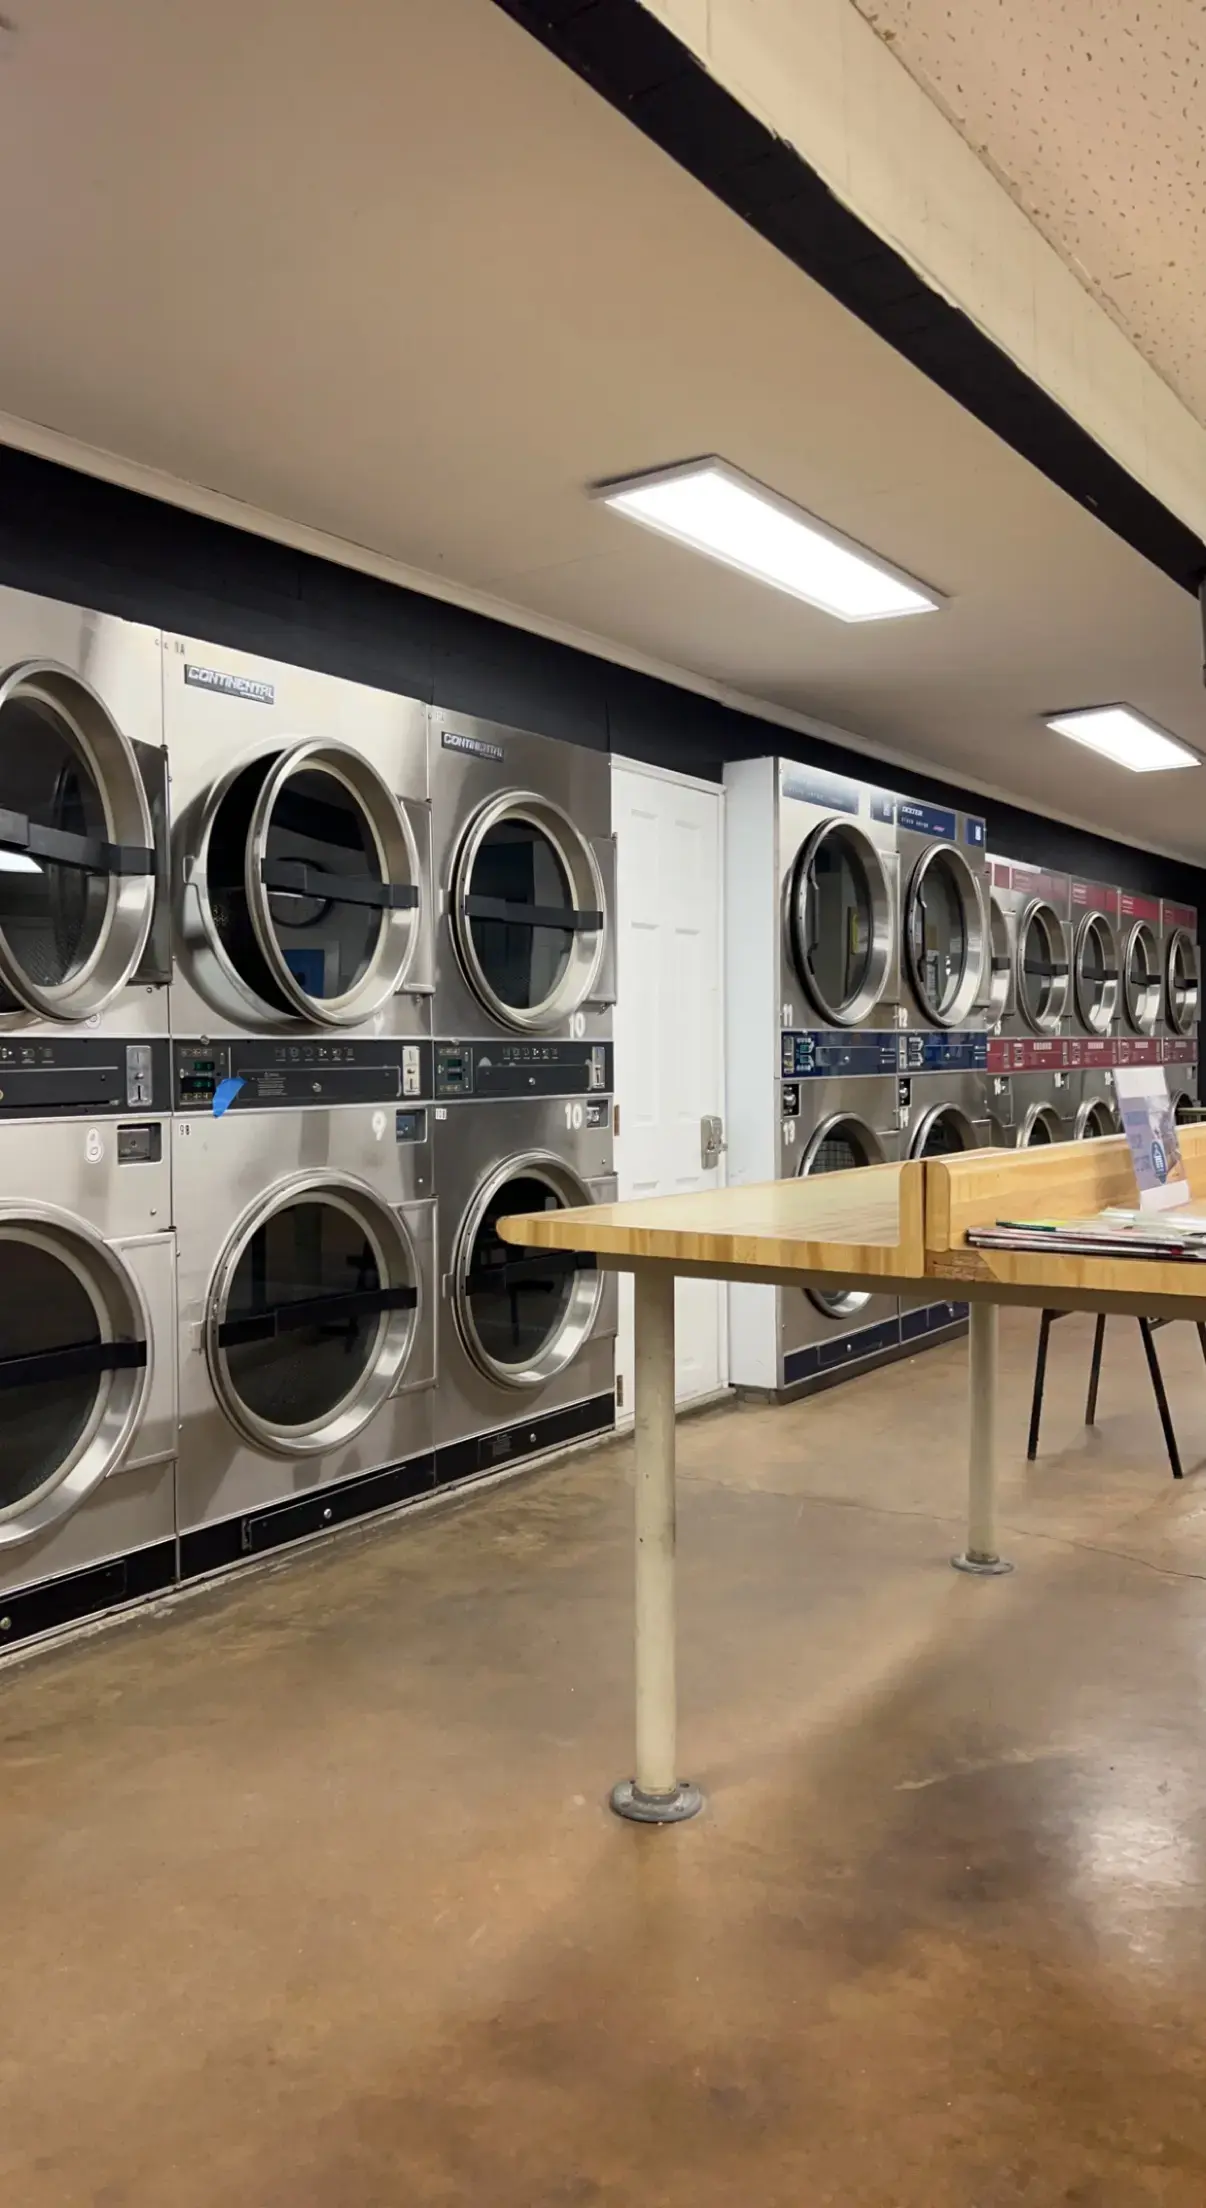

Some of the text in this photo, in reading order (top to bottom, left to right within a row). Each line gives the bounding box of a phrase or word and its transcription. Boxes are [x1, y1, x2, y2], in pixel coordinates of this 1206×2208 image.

[187, 666, 275, 699] CONTINENTAL
[568, 1012, 586, 1039] 10
[371, 1109, 387, 1141] 9
[564, 1102, 583, 1131] 10
[85, 1127, 103, 1163] 8
